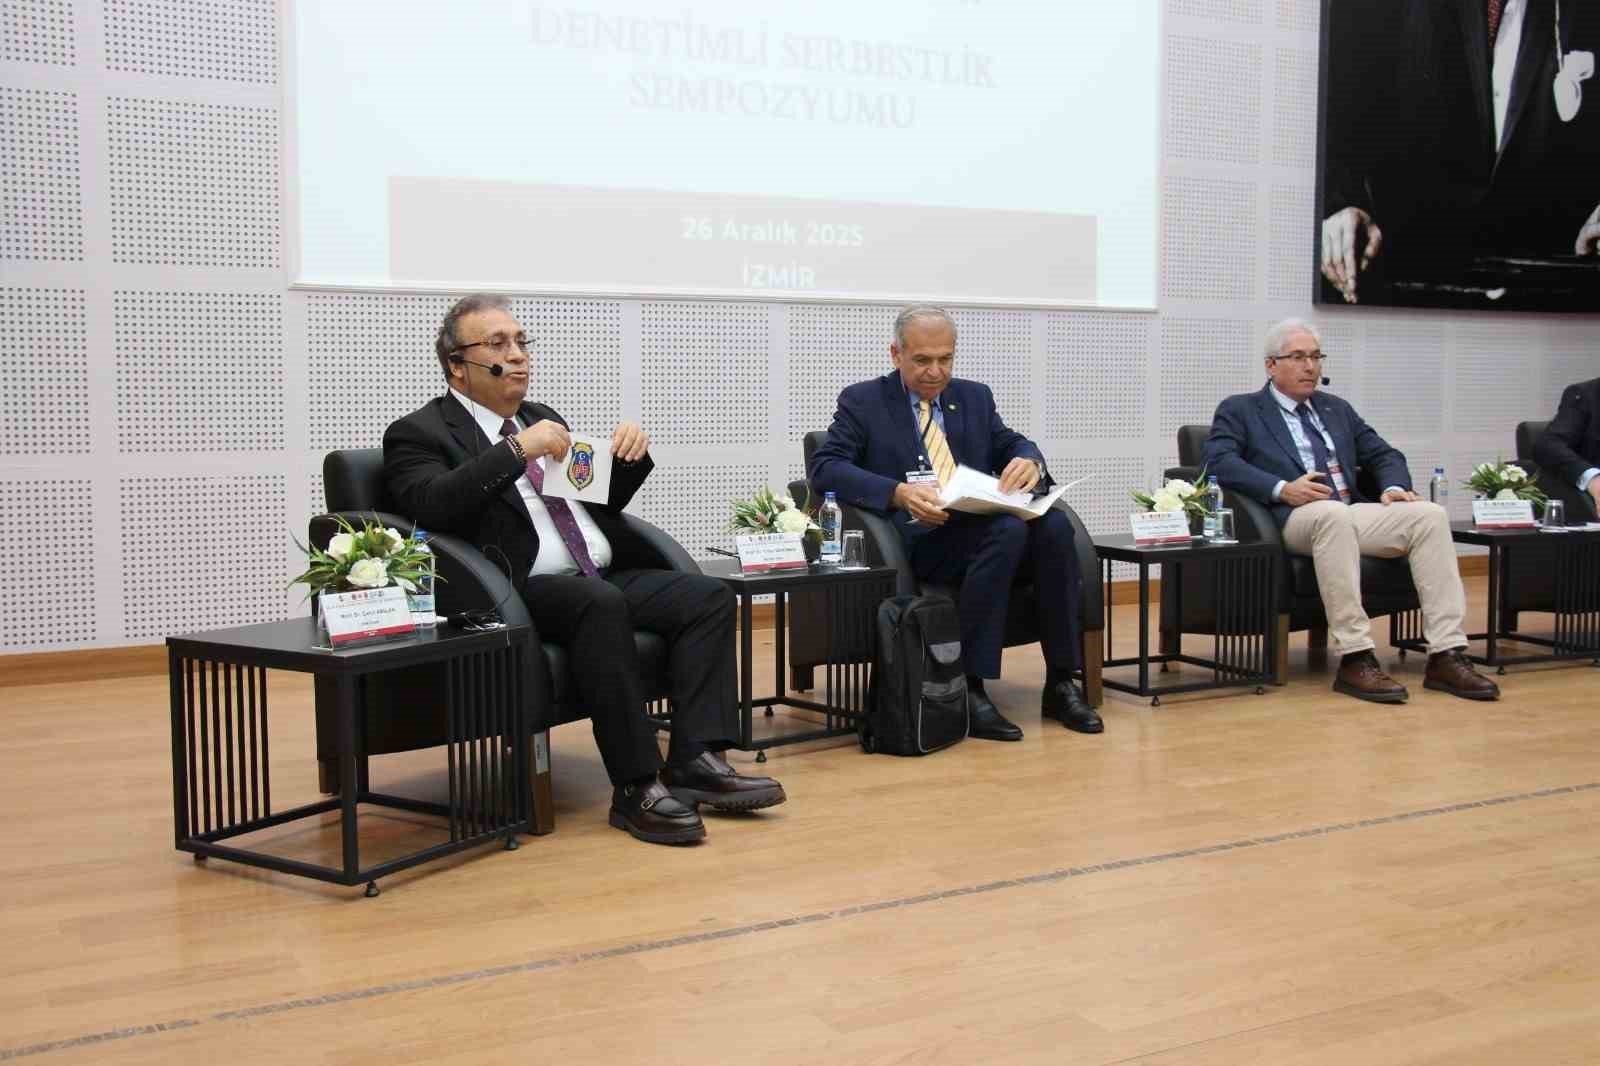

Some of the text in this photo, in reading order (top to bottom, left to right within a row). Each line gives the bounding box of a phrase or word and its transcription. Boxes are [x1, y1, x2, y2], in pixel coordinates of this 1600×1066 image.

[528, 7, 998, 89] DENETİMLİ SERBESTLİK
[627, 71, 917, 129] SEMPOZYUMU
[680, 215, 864, 248] 26 Aralık 2025
[743, 256, 816, 290] İZMİR
